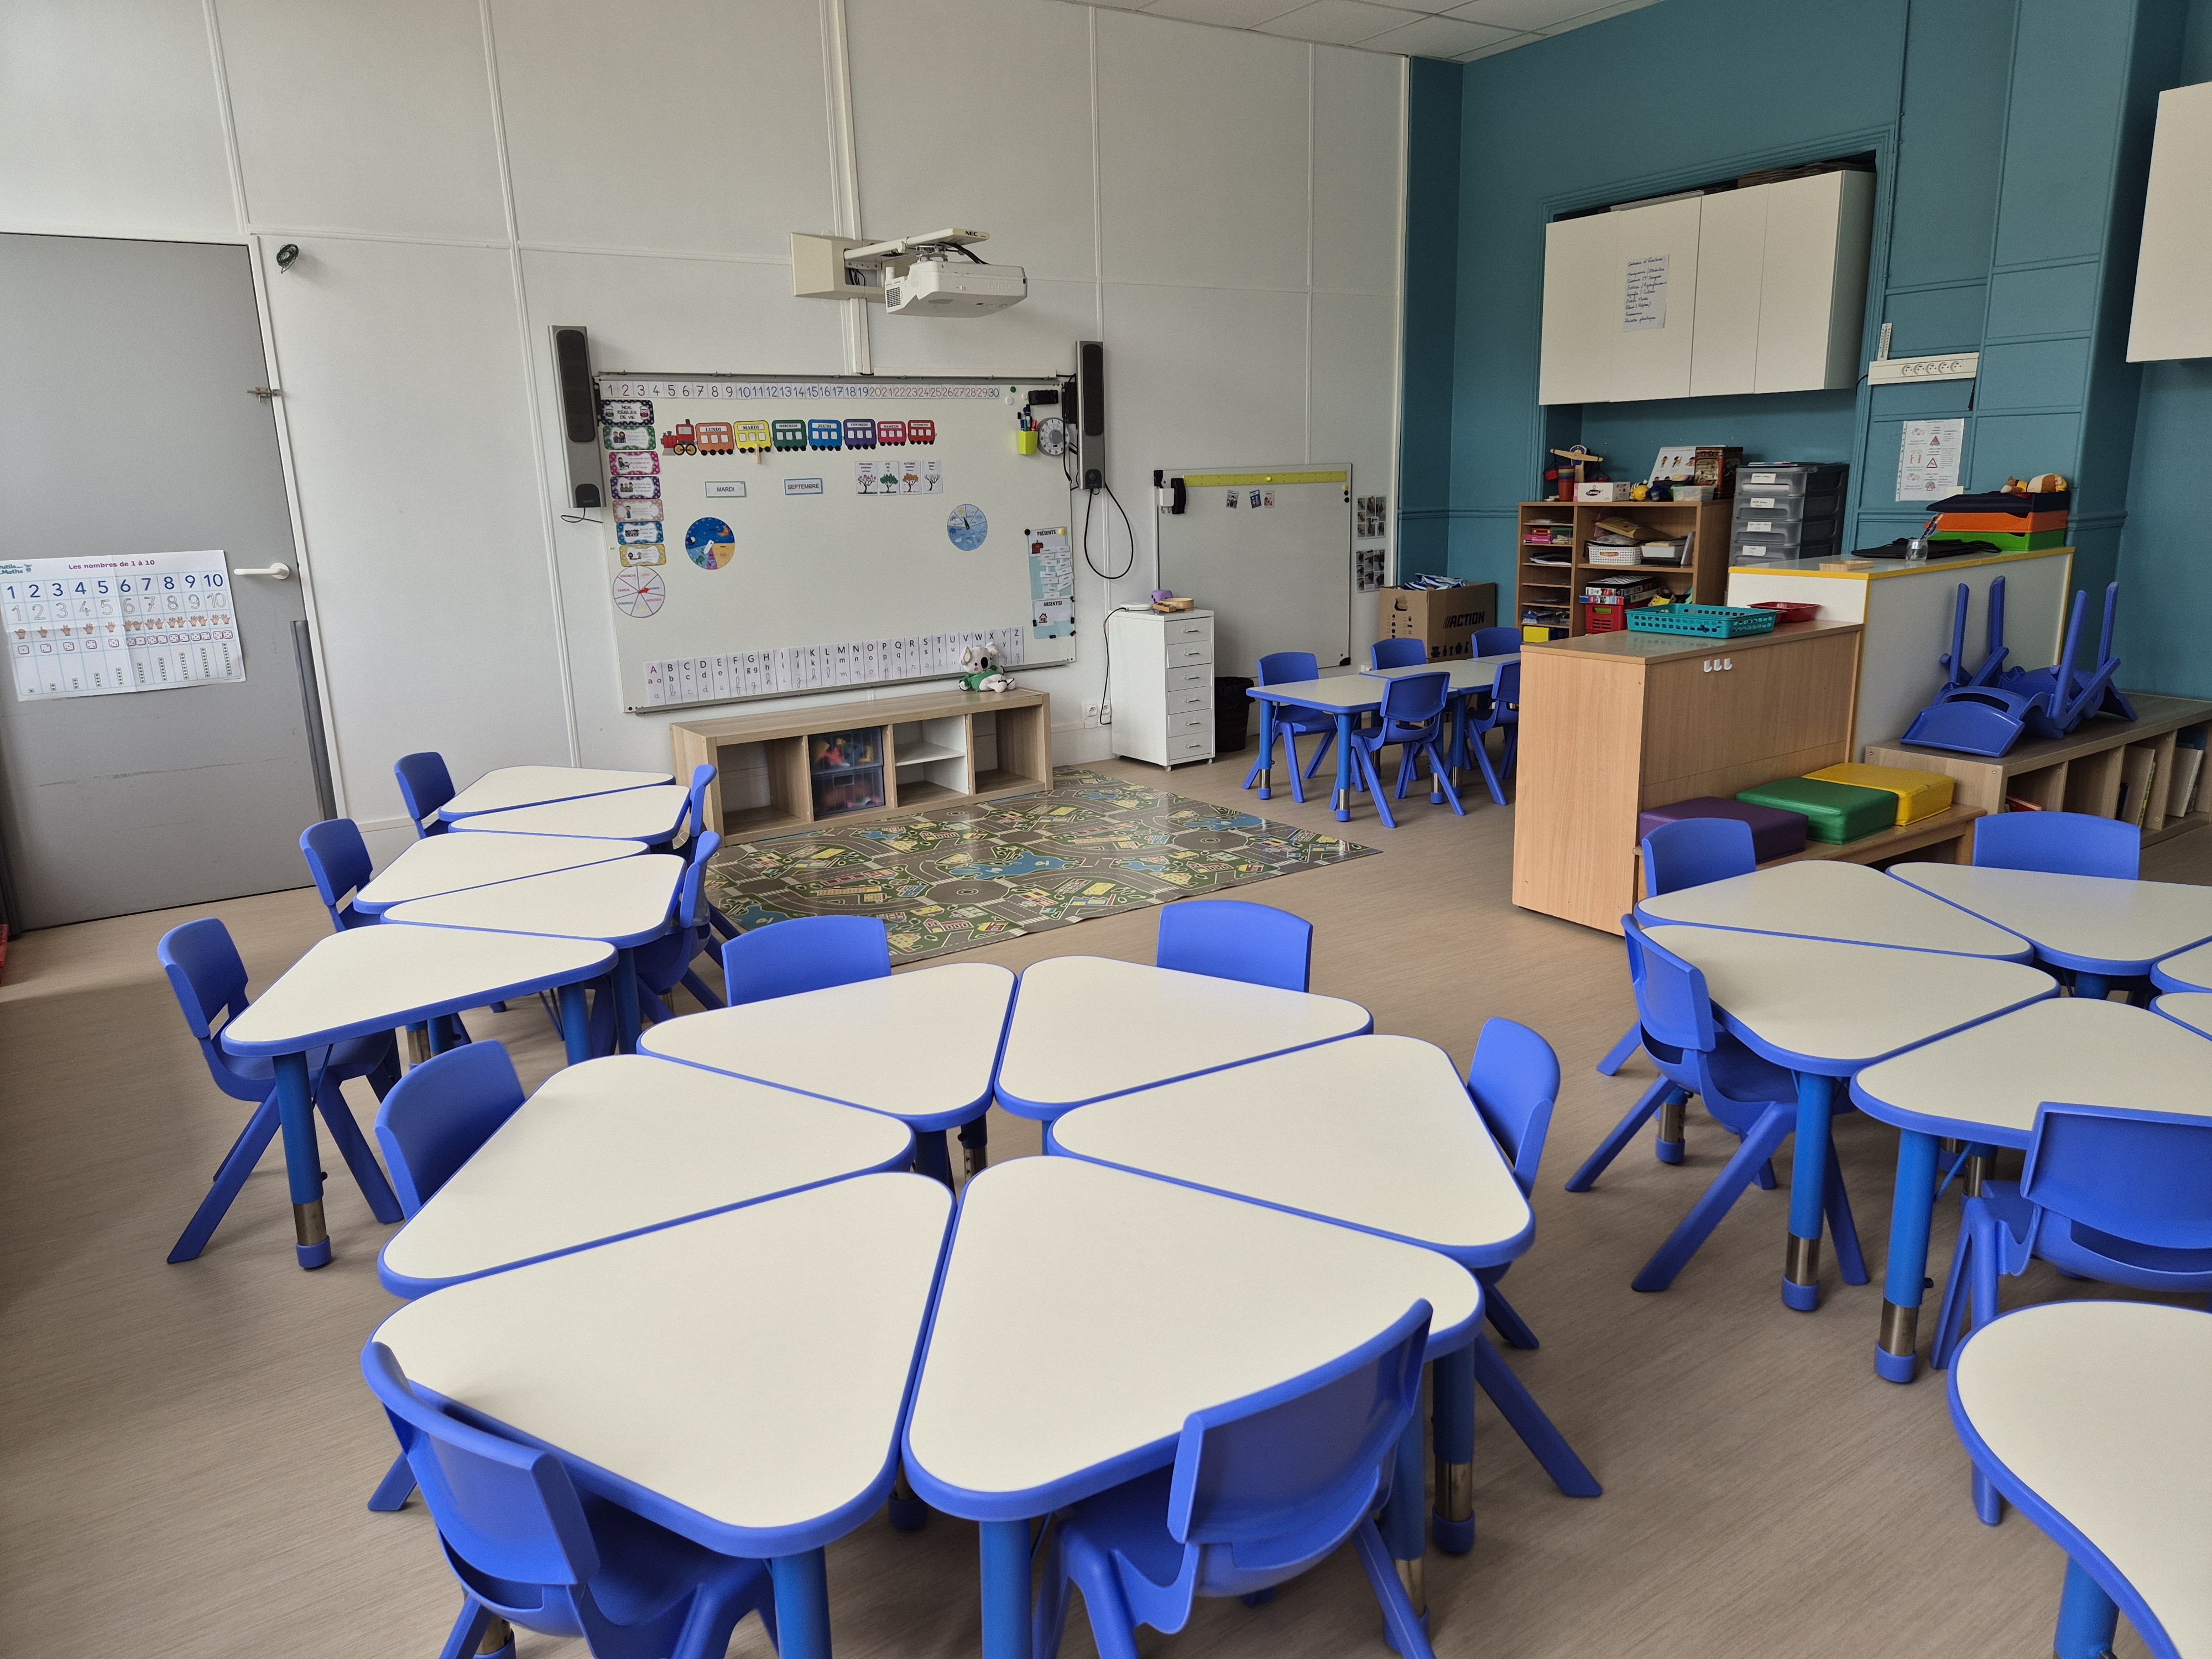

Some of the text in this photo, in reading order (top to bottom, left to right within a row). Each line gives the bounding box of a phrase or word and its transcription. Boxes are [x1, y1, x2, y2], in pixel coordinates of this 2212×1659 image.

[608, 384, 999, 398] 1 2 3 4 5 6 7 8 9 10 11 12 13 14 15 16 17 18 19 20 21 22 23 24 25 26 27 28 29 30
[7, 573, 223, 599] 1 2 3 4 5 6 7 8 9 10
[12, 592, 227, 622] 1 2 3 4 5 6 7 8 9 10
[1449, 611, 1485, 628] ACTION
[670, 684, 677, 697] b
[703, 684, 709, 693] d
[735, 676, 741, 696] f
[752, 682, 757, 694] g
[766, 672, 773, 685] h
[797, 674, 802, 688] j
[827, 667, 831, 679] l
[898, 666, 901, 677] q
[1003, 654, 1008, 665] y
